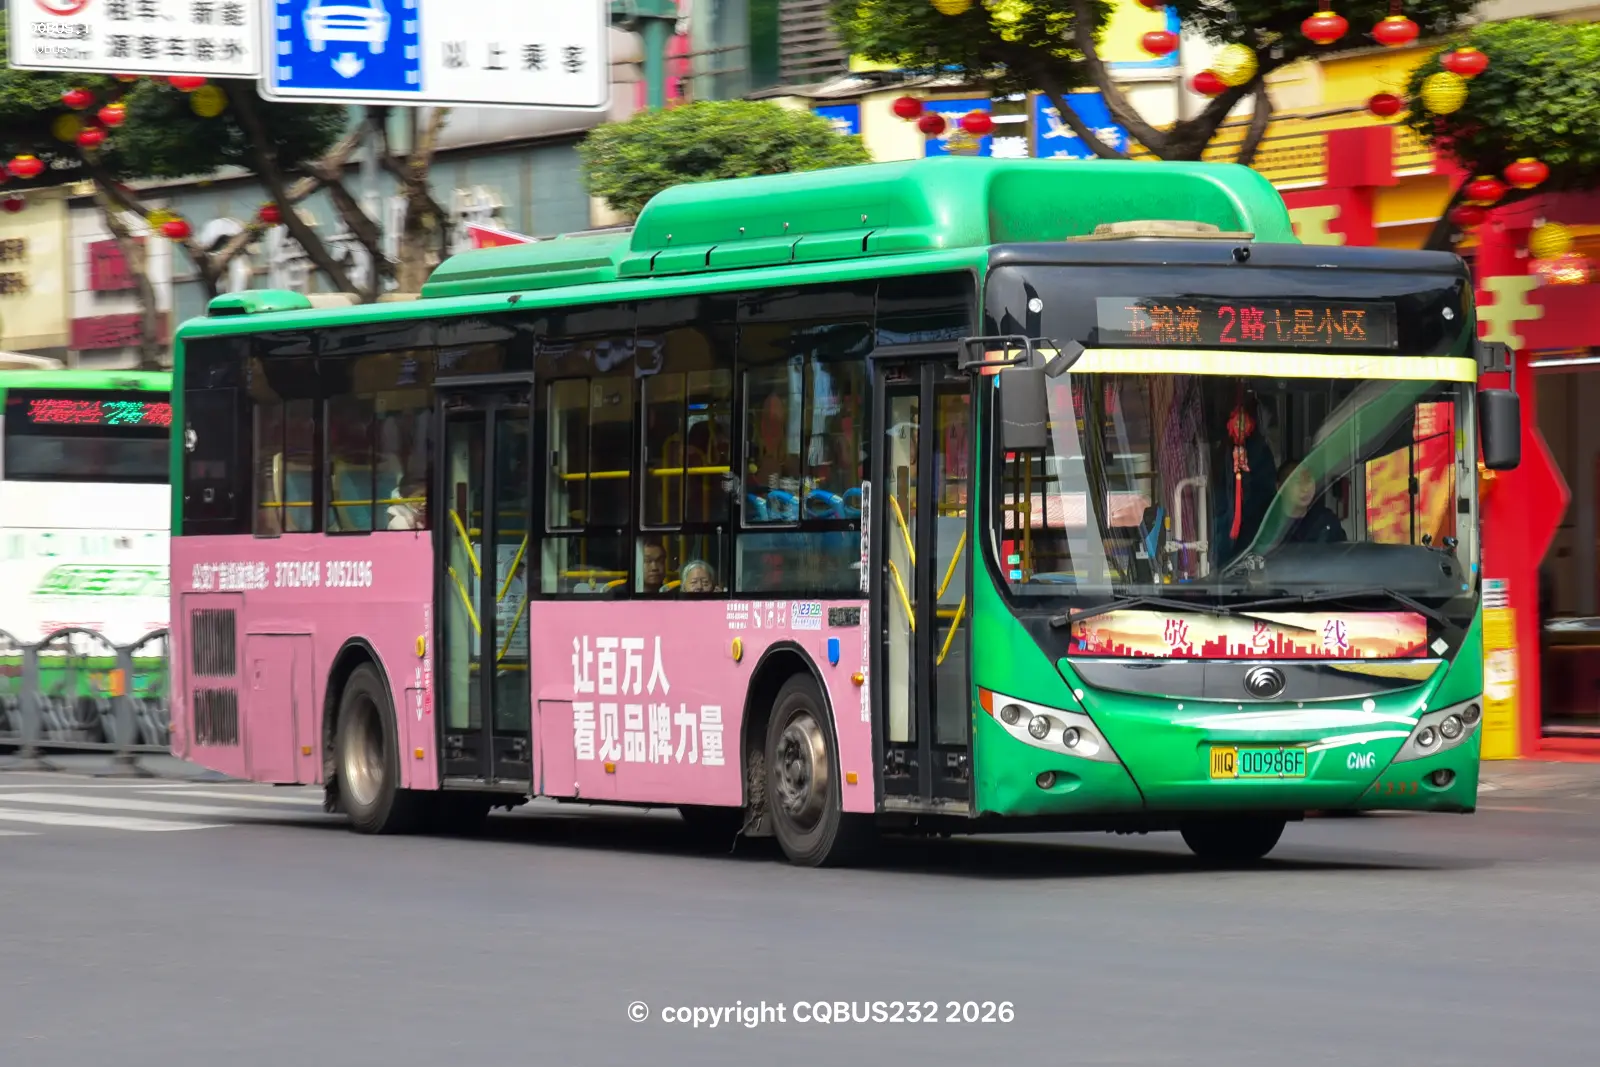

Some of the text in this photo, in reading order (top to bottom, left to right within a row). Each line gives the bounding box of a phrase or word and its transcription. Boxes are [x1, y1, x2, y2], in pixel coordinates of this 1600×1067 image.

[1217, 305, 1265, 343] 2路
[1163, 618, 1349, 649] 敬老线
[571, 635, 670, 696] 让百万人
[572, 701, 725, 766] 看见品牌力量
[1213, 751, 1305, 774] 川Q 00986F
[1346, 751, 1376, 770] CNG
